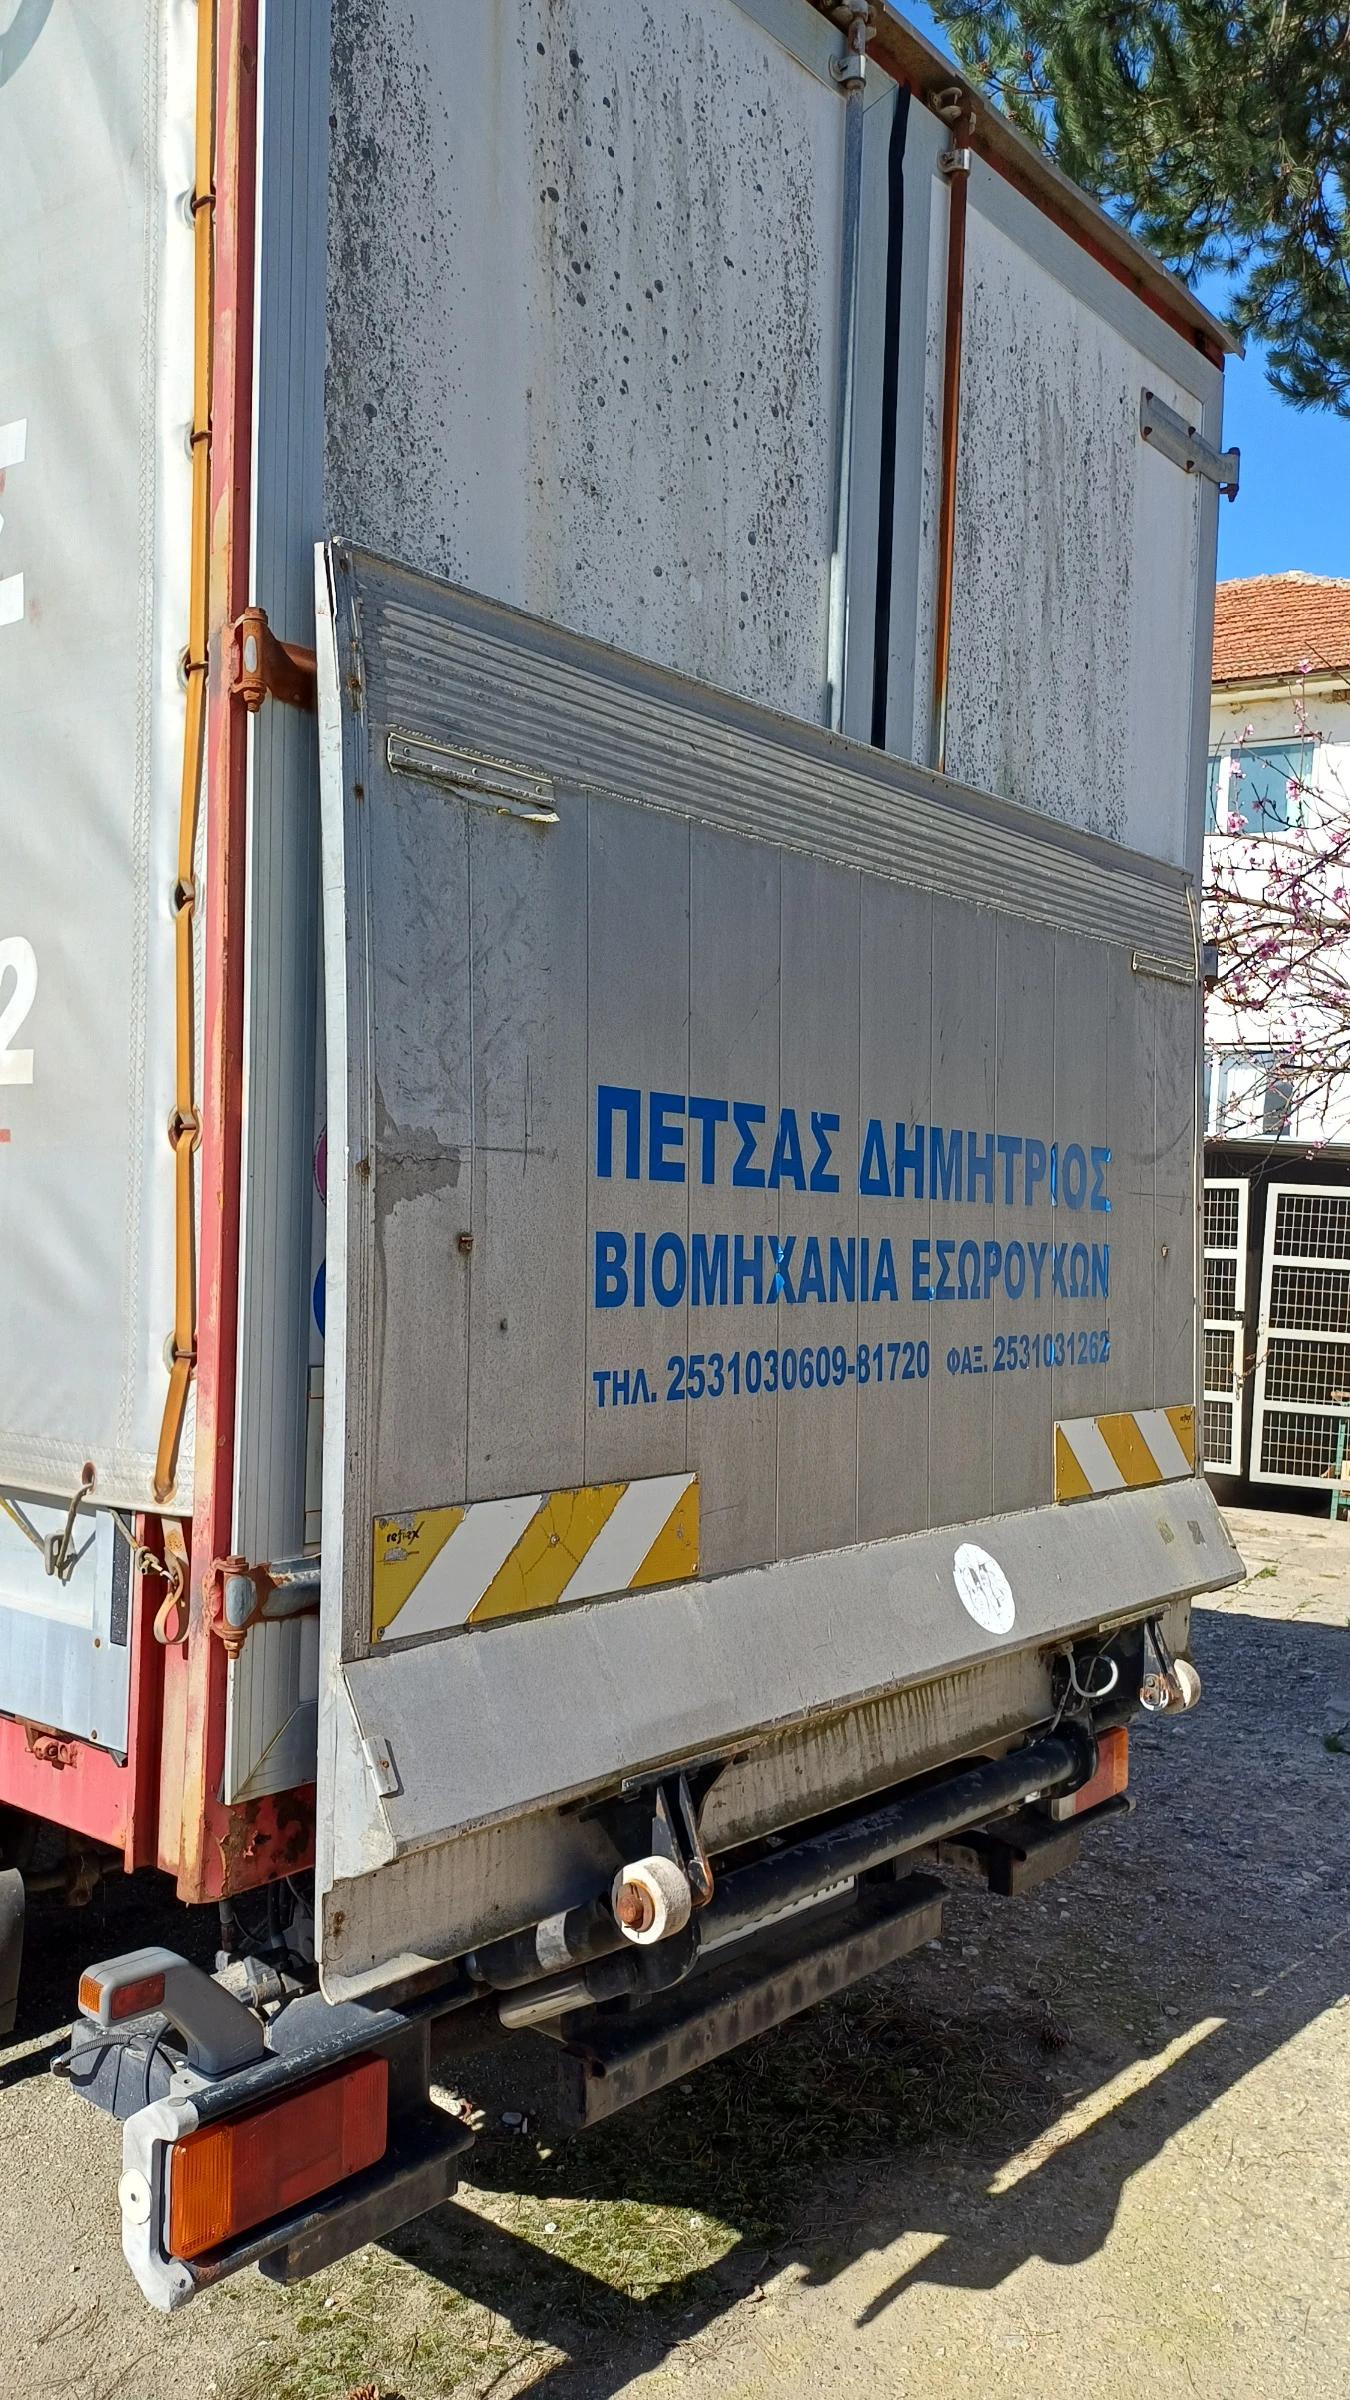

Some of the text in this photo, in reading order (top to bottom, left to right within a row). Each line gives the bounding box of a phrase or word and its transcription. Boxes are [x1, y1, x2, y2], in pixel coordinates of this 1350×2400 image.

[596, 1084, 1111, 1212] ΠΕΤΣΑΣ ΔΗΜΗΤΡΙΟΣ
[595, 1230, 1110, 1308] ΒΙΟΜΗΧΑΝΙΑ ΕΣΩΡΟΥΧΩΝ
[593, 1330, 1110, 1408] ΤΗΛ. 2531030609-81720 ΦΑΞ. 2531031262
